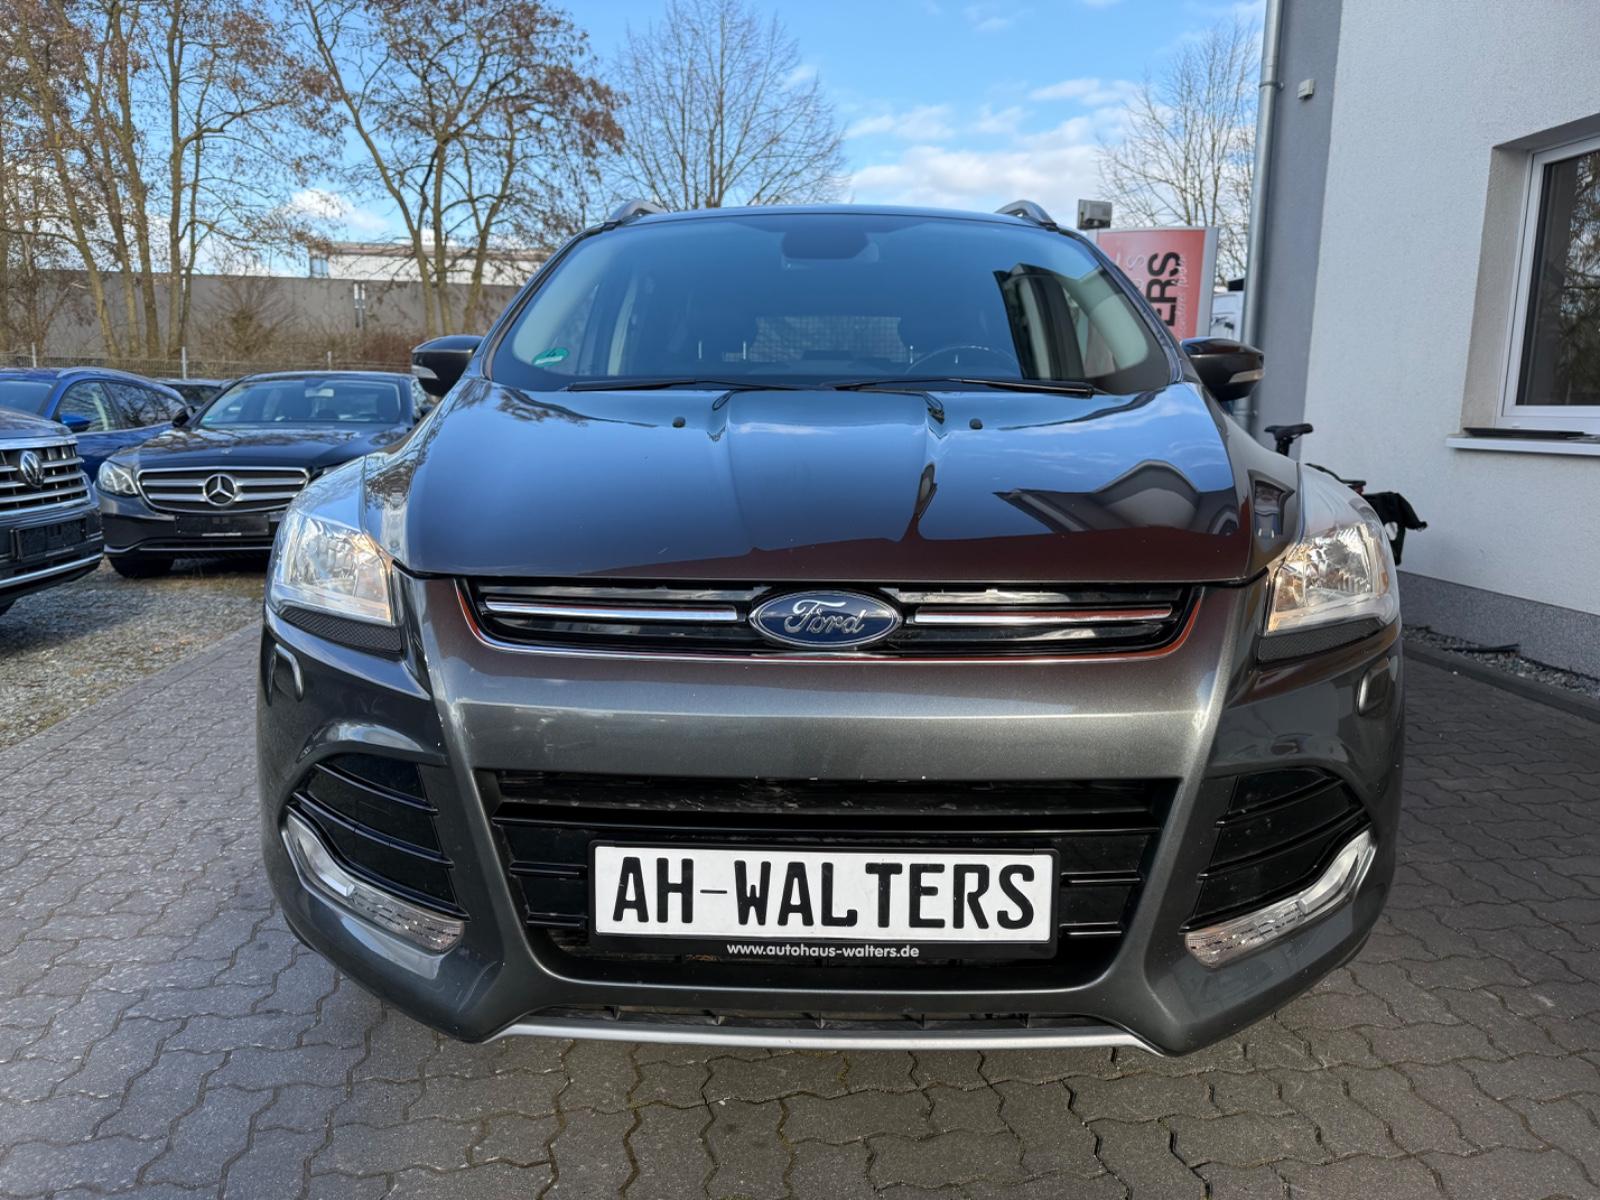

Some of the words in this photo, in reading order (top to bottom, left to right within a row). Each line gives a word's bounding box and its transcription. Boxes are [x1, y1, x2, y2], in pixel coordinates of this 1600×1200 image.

[784, 599, 867, 634] Ford
[612, 856, 1035, 930] AH-WALTERS
[726, 943, 920, 959] www.autohaus-walters.de
